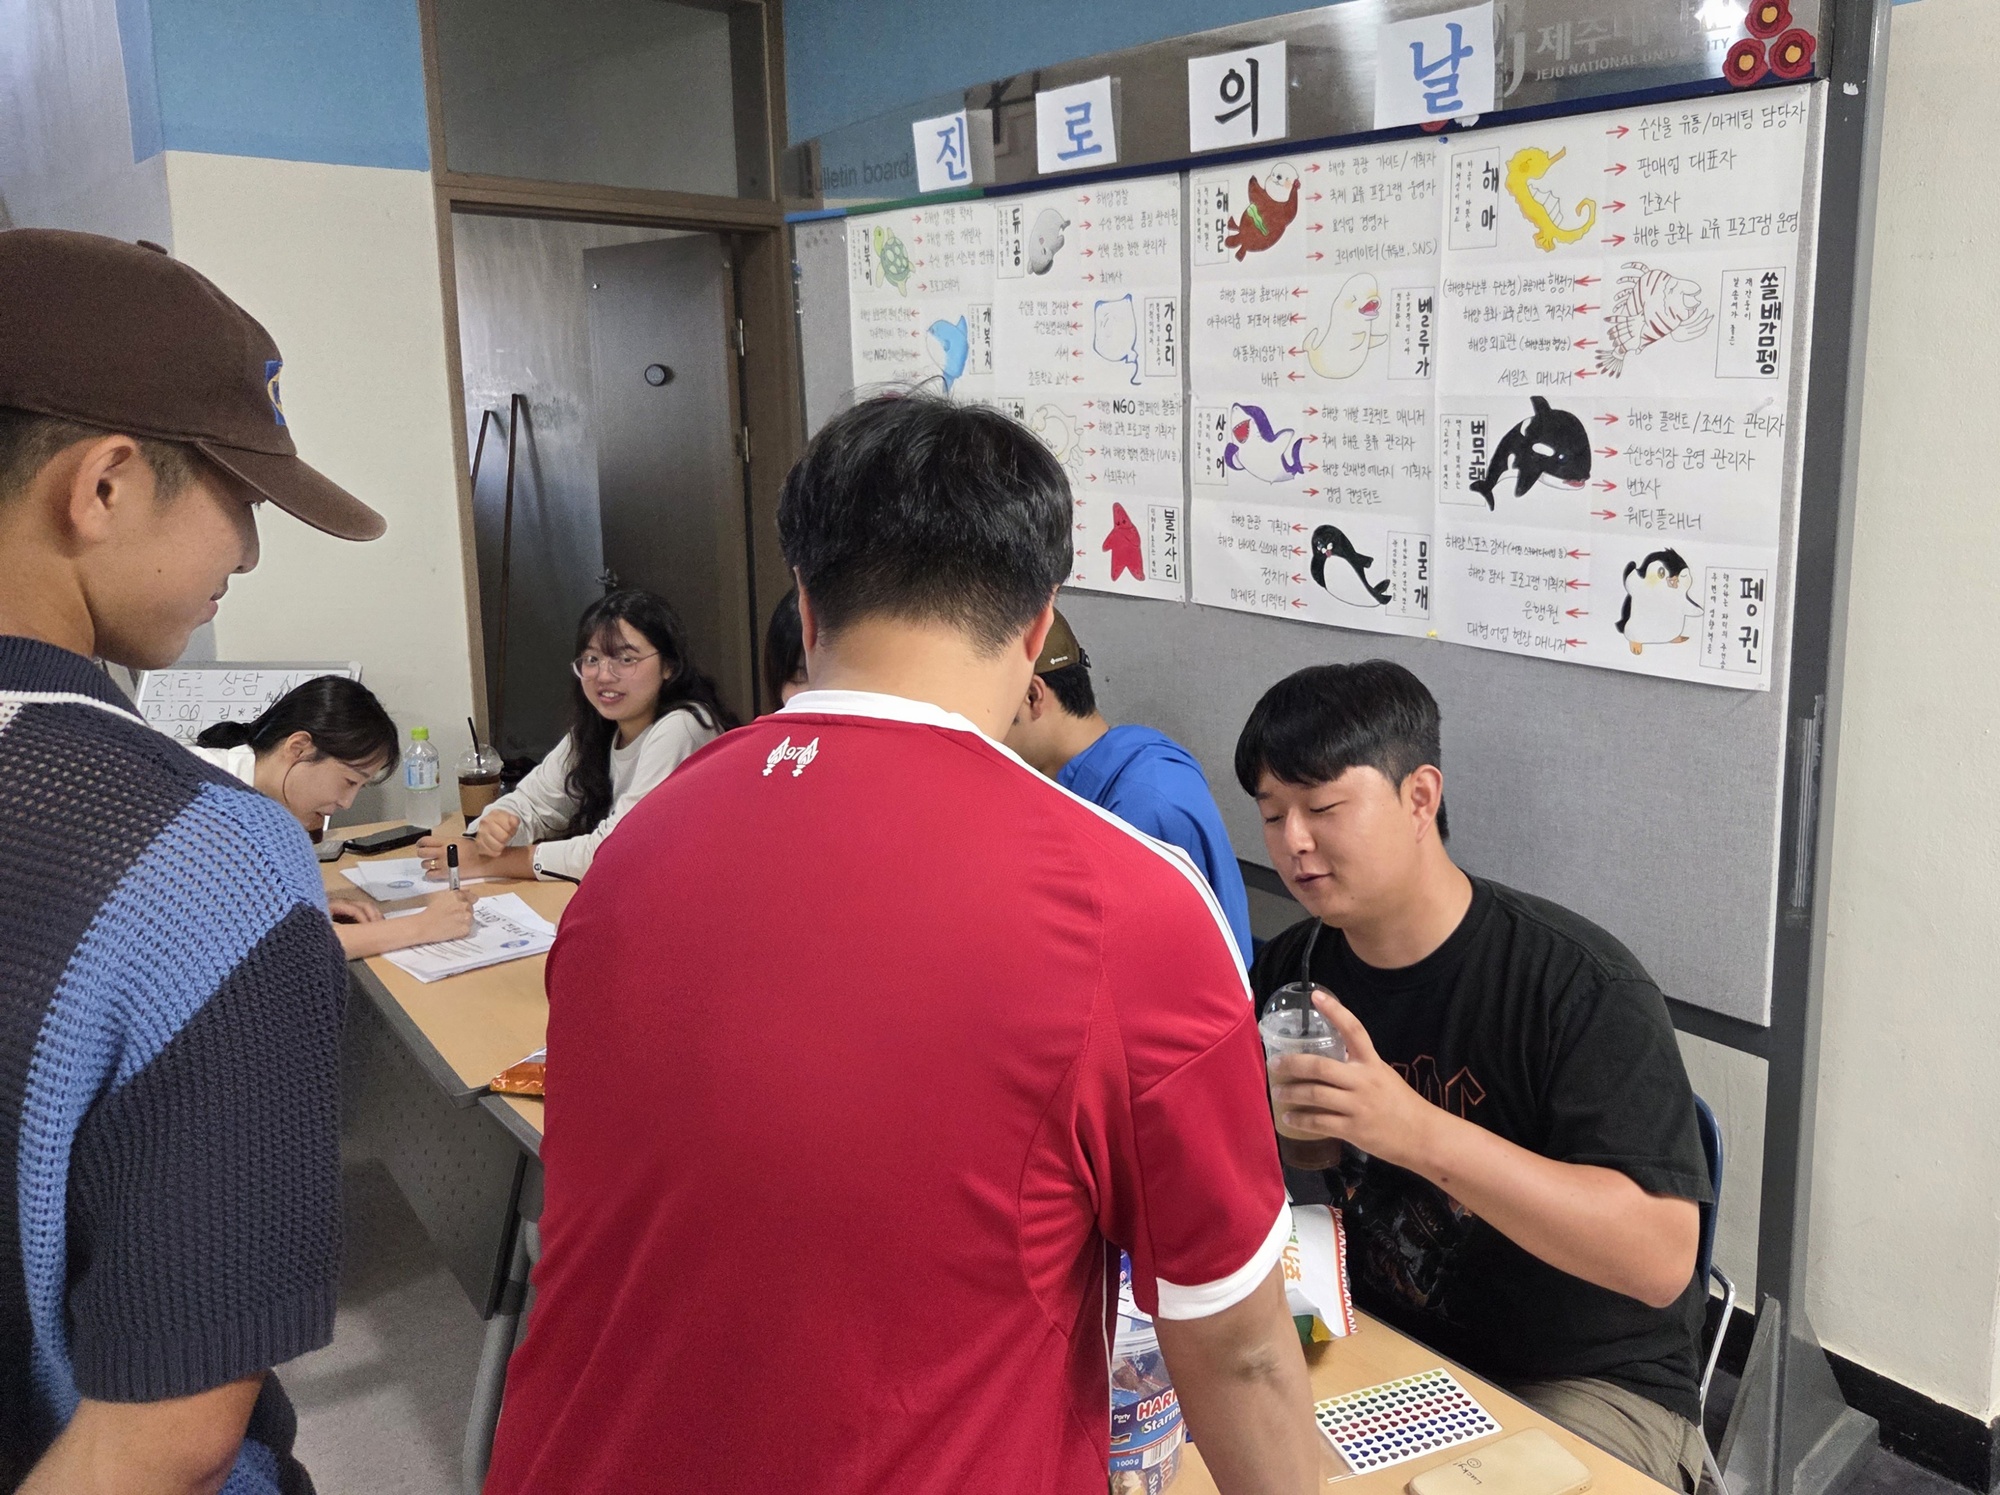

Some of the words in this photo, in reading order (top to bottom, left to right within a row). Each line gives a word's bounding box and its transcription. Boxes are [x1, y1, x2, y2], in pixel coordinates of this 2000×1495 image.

[1535, 64, 1565, 82] JEJU
[936, 116, 968, 181] 진
[1057, 102, 1103, 161] 로
[1214, 57, 1259, 138] 의
[1410, 22, 1474, 115] 날
[1679, 108, 1754, 135] 유통/마케팅
[1762, 101, 1807, 128] 담당자
[1328, 160, 1346, 176] 해양
[1637, 154, 1680, 179] 판매업
[1689, 148, 1738, 173] 대표자
[1329, 188, 1346, 204] 국제
[1352, 186, 1364, 204] 교류
[1407, 179, 1437, 200] 운영자
[1481, 161, 1499, 231] 해마
[1639, 190, 1682, 217] 간호사
[1216, 187, 1229, 253] 해달
[1360, 214, 1389, 232] 경영자
[1633, 224, 1660, 248] 해양
[1699, 218, 1721, 240] 교류
[1726, 213, 1772, 236] 프로그램
[1776, 211, 1799, 234] 운영
[1012, 207, 1021, 267] 듀공
[1143, 237, 1167, 256] 관리자
[863, 227, 873, 287] 거북이
[1220, 287, 1236, 304] 해양
[1240, 288, 1256, 304] 관광
[1260, 285, 1288, 303] 홍보대사
[1207, 312, 1240, 330] 아쿠아리움
[1463, 306, 1481, 323] 해양
[1544, 304, 1575, 322] 제작자
[1756, 272, 1782, 375] 쏠배감펭
[1164, 301, 1175, 367] 가오리
[1414, 296, 1433, 377] 벨루가
[1468, 336, 1488, 353] 해양
[1489, 333, 1516, 351] 외교관
[1261, 371, 1279, 387] 배우
[1497, 368, 1529, 387] 세일즈
[1536, 370, 1571, 386] 매니저
[1113, 399, 1136, 415] NGO
[1321, 404, 1339, 422] 해양
[1362, 408, 1391, 425] 프로젝트
[1396, 409, 1425, 427] 매니저
[1154, 425, 1176, 440] 기획자
[1627, 407, 1653, 431] 해양
[1659, 410, 1735, 435] 플랜트/조선소
[1743, 412, 1785, 438] 관리자
[1215, 413, 1227, 478] 상어
[1321, 432, 1337, 449] 국제
[1342, 433, 1360, 450] 해운
[1384, 434, 1416, 452] 관리자
[1468, 420, 1486, 481] 범고래
[1321, 460, 1339, 477] 해양
[1401, 462, 1432, 480] 기획자
[1623, 444, 1678, 469] 수산양식장
[1682, 448, 1705, 470] 운영
[1710, 447, 1756, 472] 관리자
[1323, 487, 1341, 504] 경영
[1346, 488, 1382, 505] 컨설턴트
[1626, 477, 1661, 500] 변호사
[1267, 518, 1291, 536] 기획자
[1164, 508, 1177, 580] 불가사리
[1217, 532, 1234, 548] 해양
[1260, 567, 1289, 587] 정치가
[1414, 541, 1428, 611] 물개
[1468, 563, 1485, 581] 해양
[1543, 577, 1567, 592] 기획자
[1230, 588, 1256, 606] 마케팅
[1261, 593, 1287, 611] 디렉터
[1522, 601, 1559, 625] 은행원
[1738, 577, 1764, 664] 펭귄
[1512, 627, 1532, 647] 현장
[1535, 635, 1567, 654] 매니저
[219, 671, 264, 696] 상담
[783, 746, 807, 760] 97
